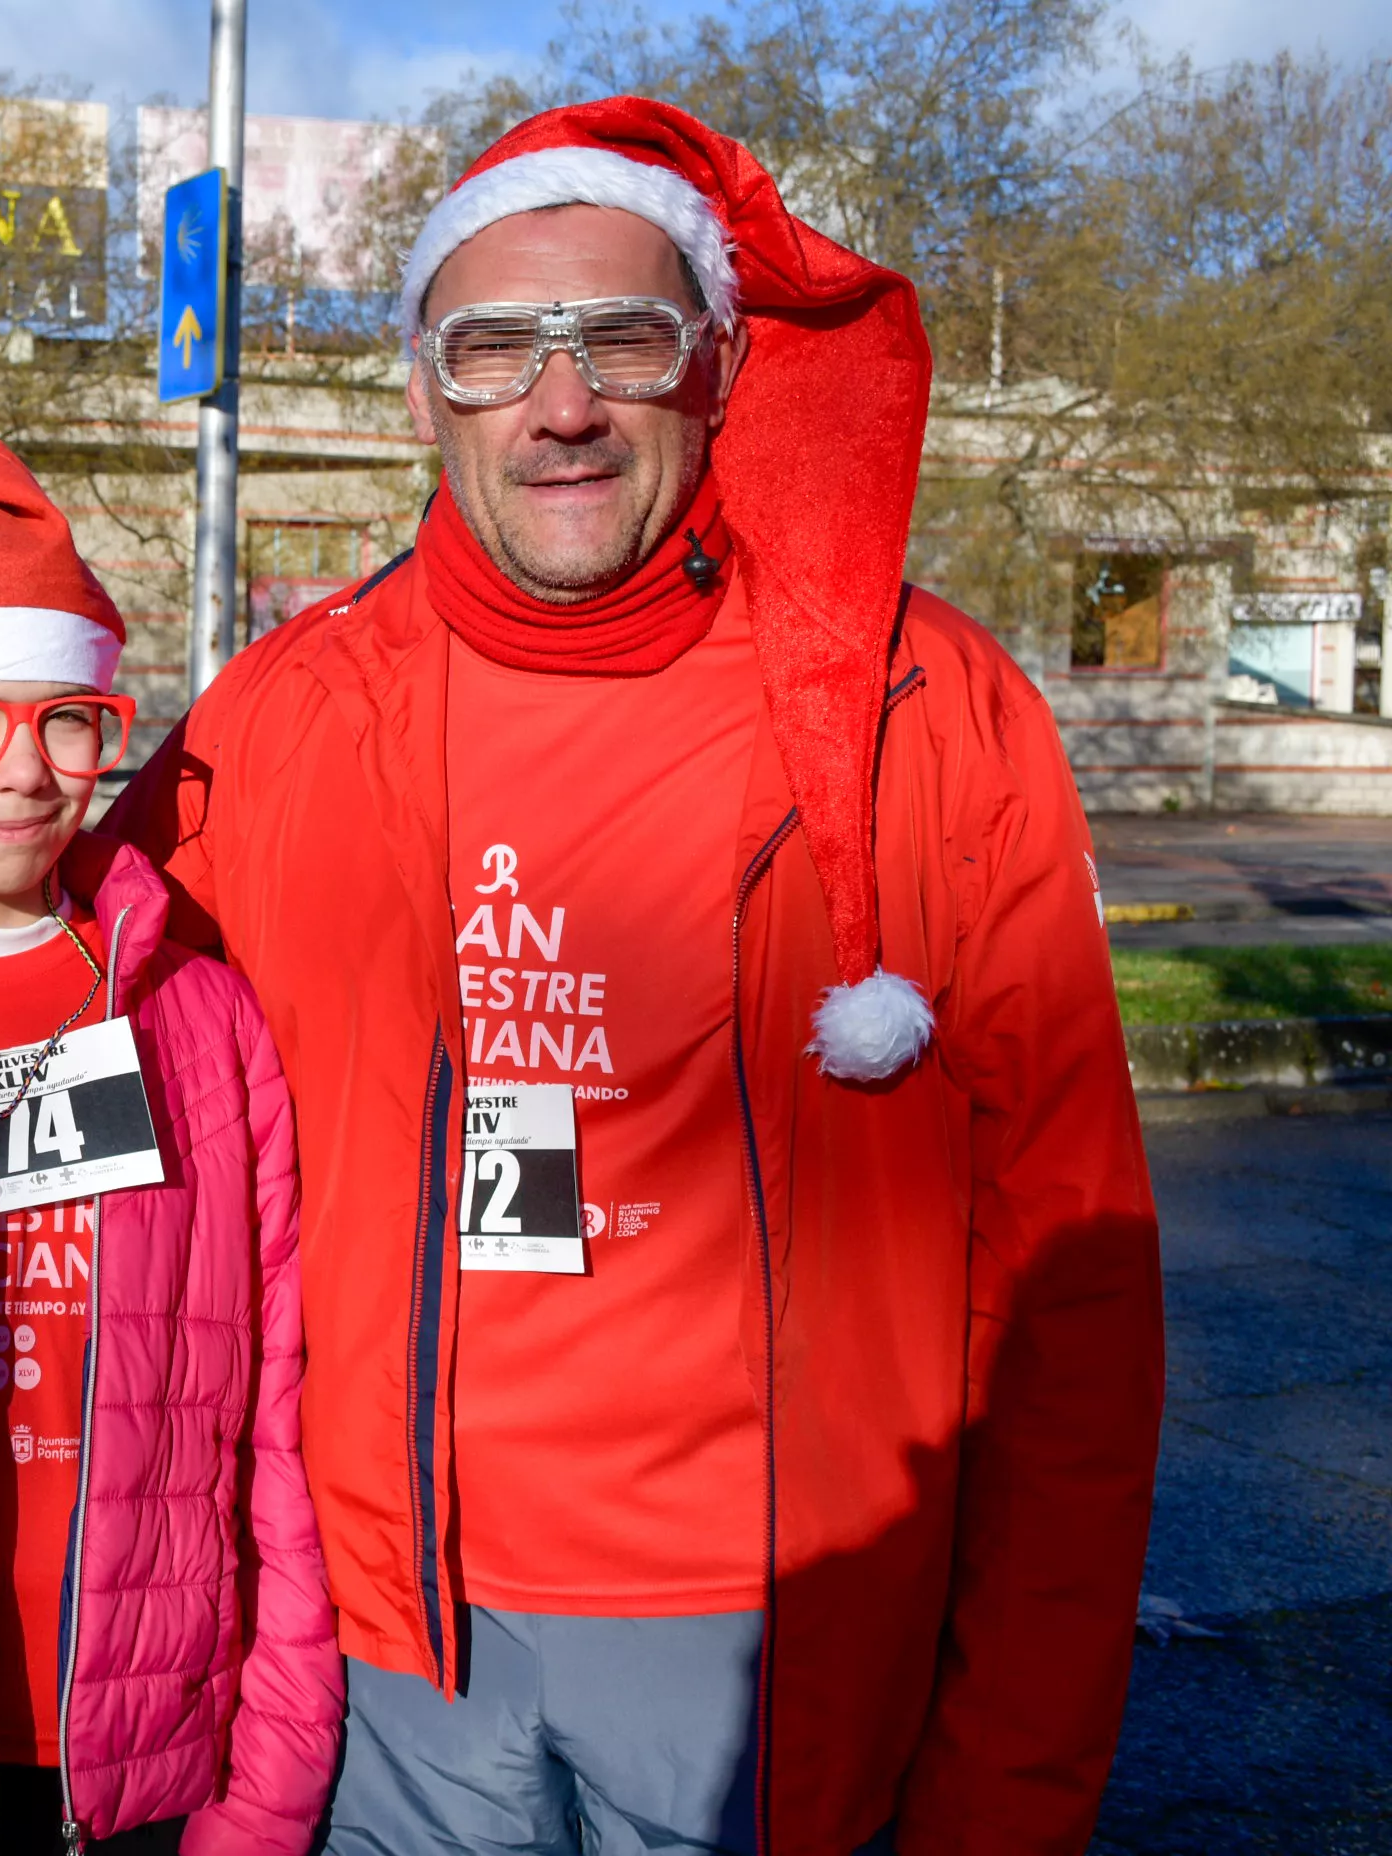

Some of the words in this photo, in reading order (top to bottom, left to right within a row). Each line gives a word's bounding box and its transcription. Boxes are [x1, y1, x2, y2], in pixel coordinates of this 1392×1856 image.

[462, 1016, 615, 1075] IANA
[618, 1207, 660, 1217] RUNNING
[618, 1216, 641, 1224] PARA
[618, 1222, 649, 1231] TODOS
[14, 1301, 67, 1316] TIEMPO
